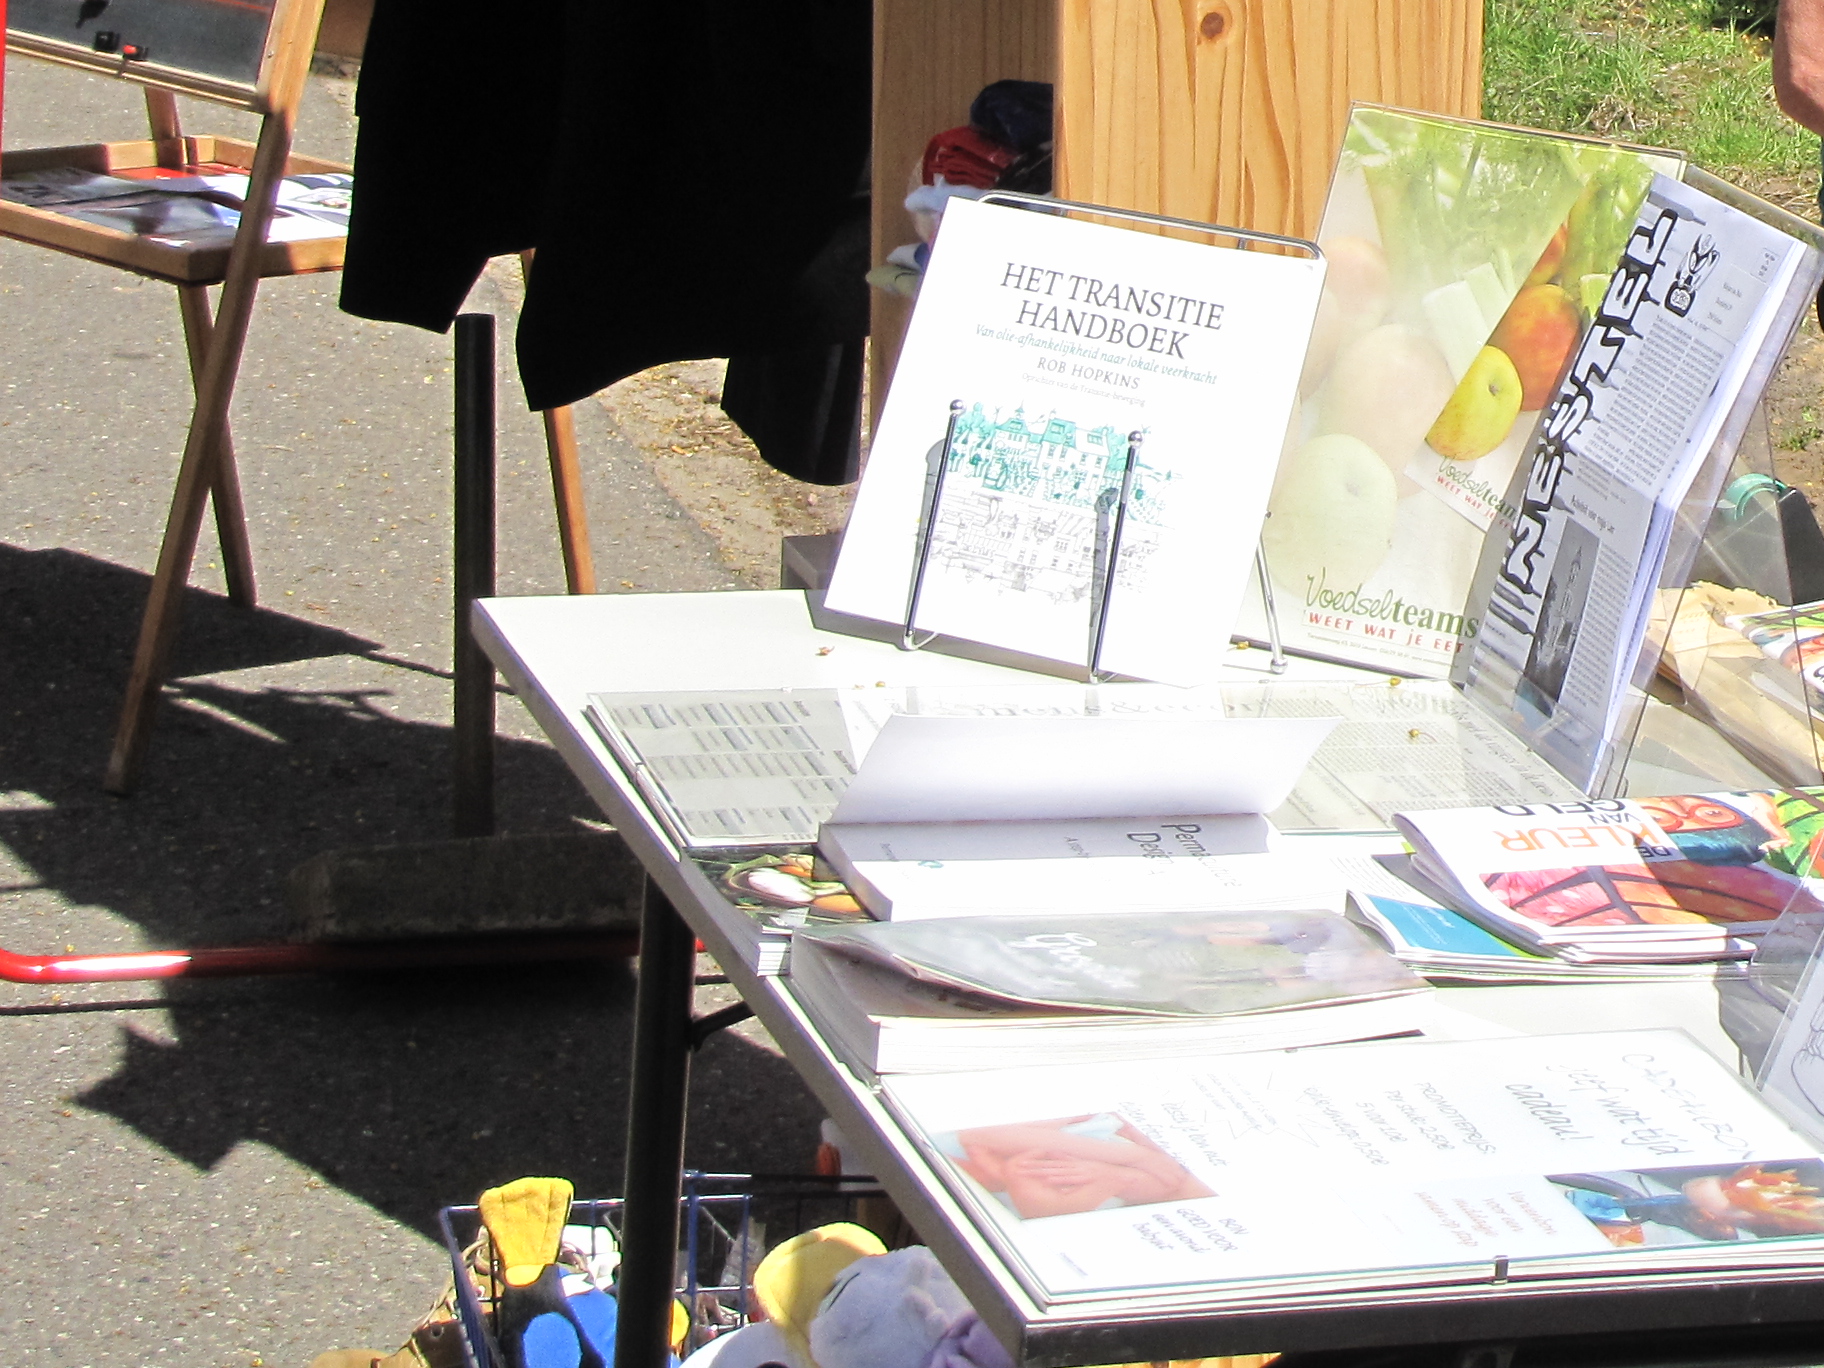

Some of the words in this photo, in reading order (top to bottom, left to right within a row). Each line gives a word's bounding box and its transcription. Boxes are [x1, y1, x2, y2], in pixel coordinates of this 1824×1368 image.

[1000, 262, 1064, 297] HET
[1067, 274, 1225, 331] TRANSITIE
[1015, 299, 1190, 360] HANDBOEK
[976, 324, 995, 339] Van
[995, 329, 1100, 361] olie-afhankelijkheid
[1100, 351, 1126, 367] naar
[1127, 354, 1160, 374] lokale
[1160, 363, 1218, 386] veerkracht
[1036, 356, 1067, 374] ROB
[1071, 363, 1141, 391] HOPKINS
[1306, 566, 1480, 640] Voedselteams
[1308, 612, 1354, 631] WEET
[1364, 624, 1397, 640] WAT
[1433, 639, 1465, 653] EET
[1492, 823, 1660, 852] KLEUR
[1586, 811, 1641, 826] VAN
[1634, 846, 1672, 858] DE
